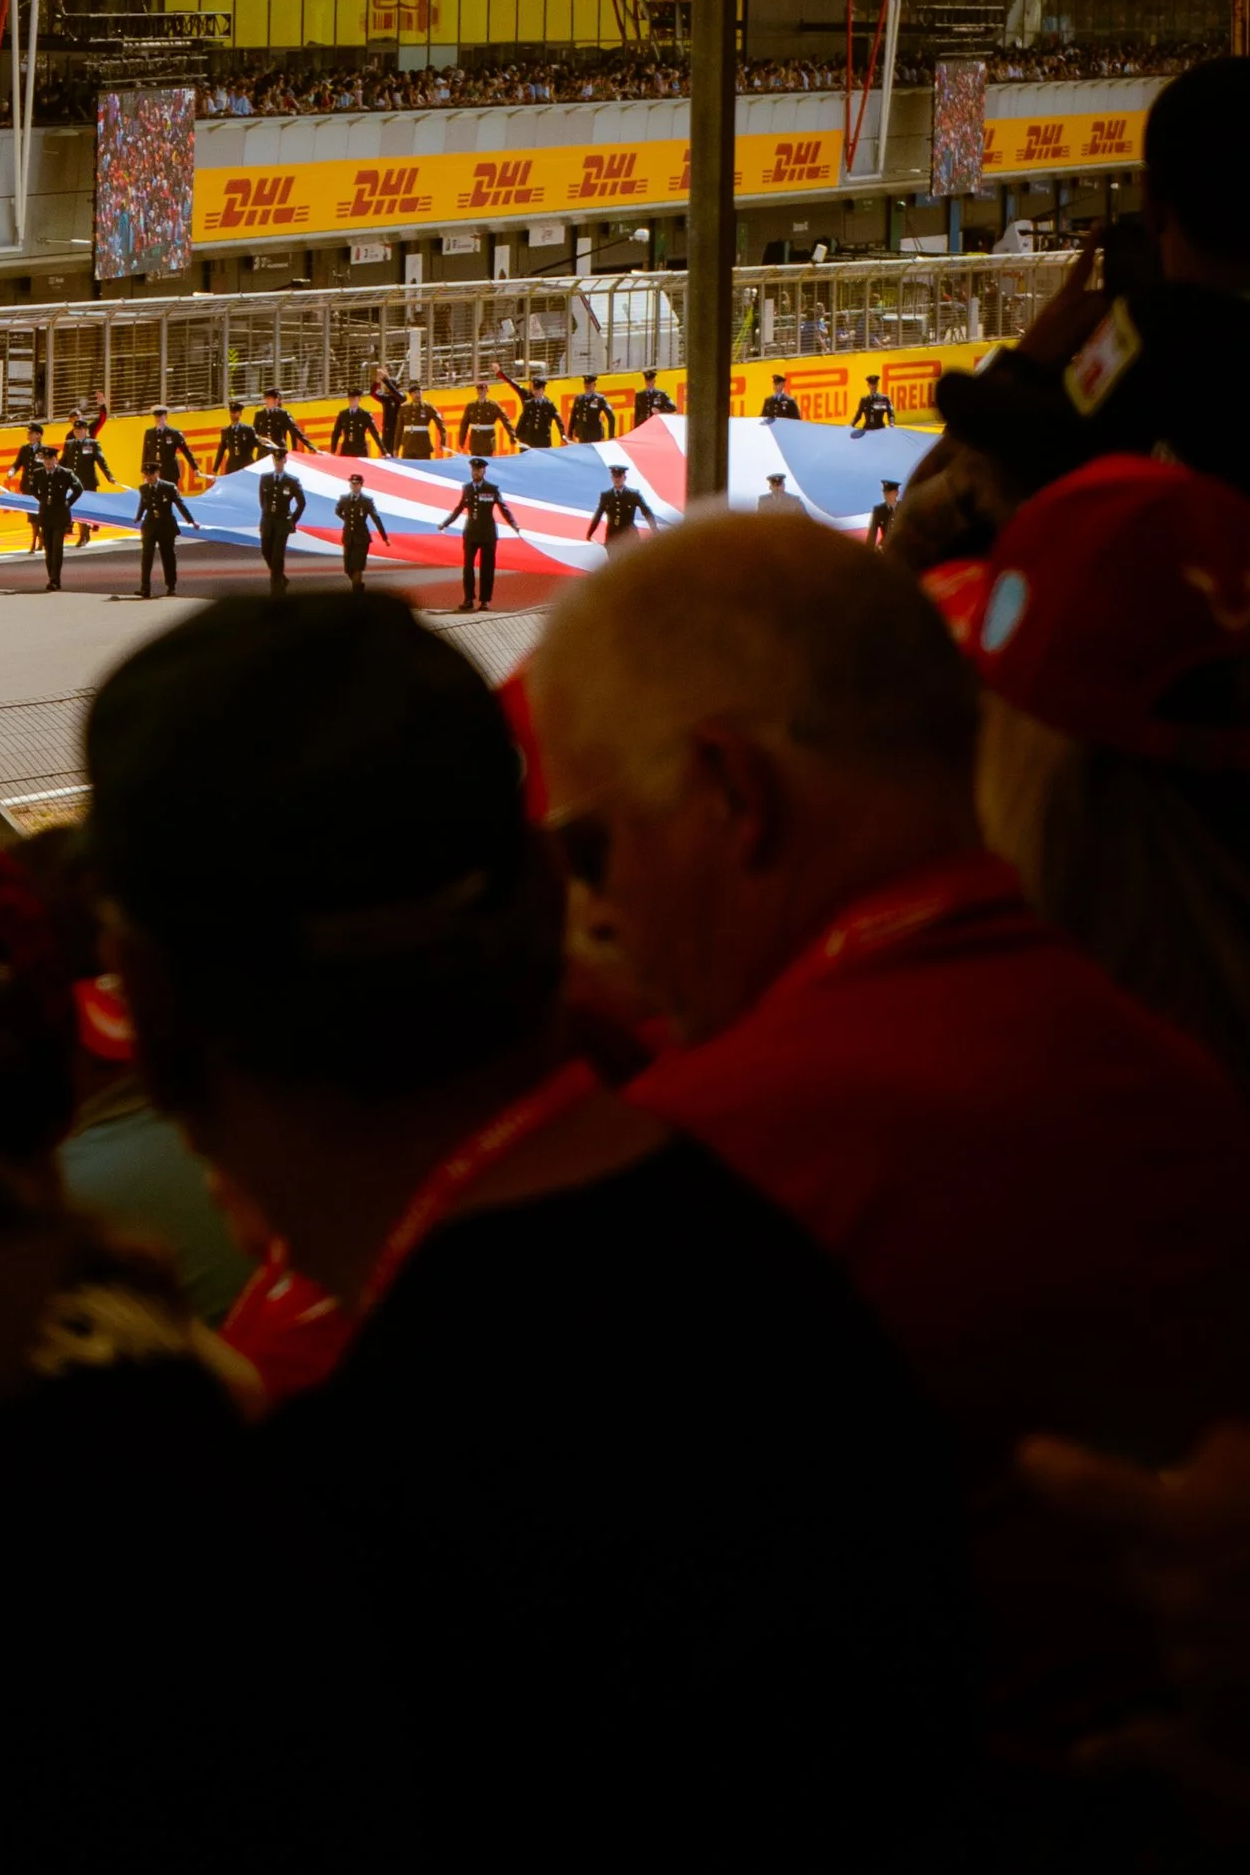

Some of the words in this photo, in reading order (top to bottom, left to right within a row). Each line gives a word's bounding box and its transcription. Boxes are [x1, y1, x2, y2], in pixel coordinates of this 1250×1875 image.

[1024, 124, 1063, 161] DHL
[1089, 120, 1126, 155] DHL
[469, 160, 533, 208] DHL
[578, 153, 637, 198] DHL
[771, 141, 822, 183] DHL
[219, 176, 295, 228] DHL
[349, 167, 420, 217] DHL
